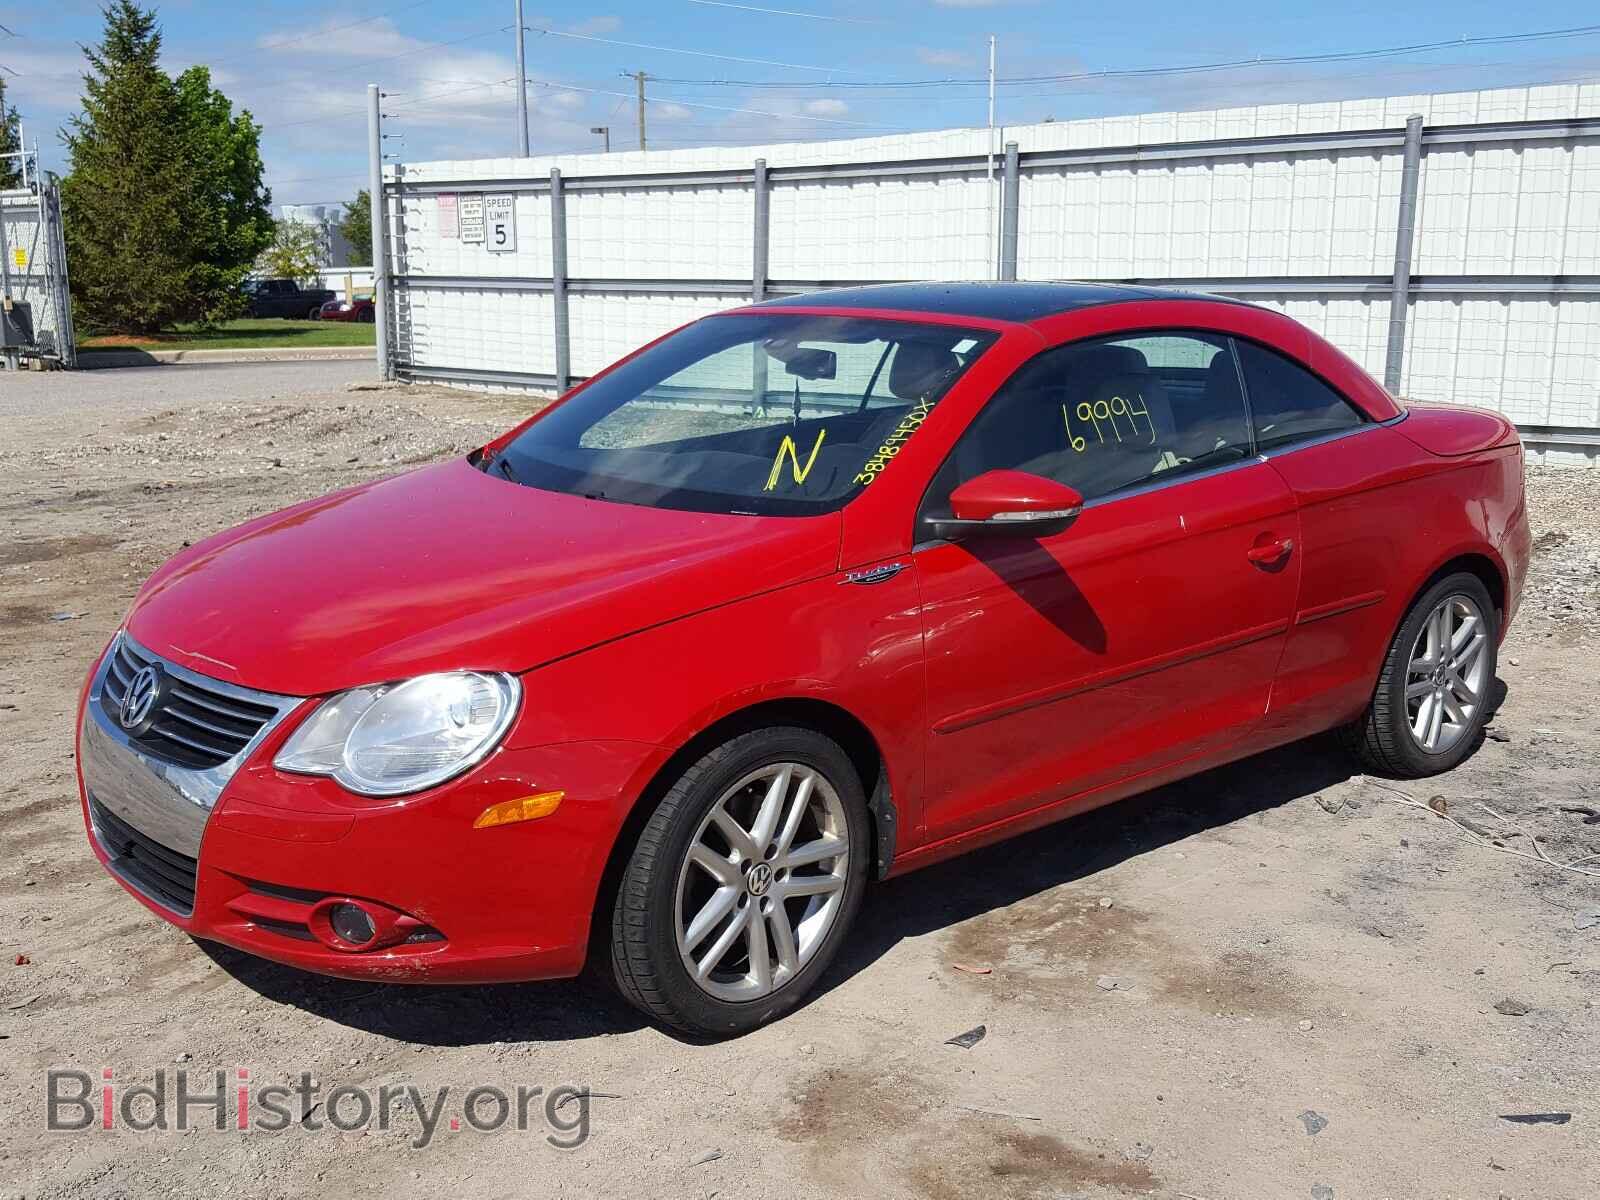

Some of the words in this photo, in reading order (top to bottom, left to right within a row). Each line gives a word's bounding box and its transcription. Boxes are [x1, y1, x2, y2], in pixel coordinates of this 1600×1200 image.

[487, 198, 511, 208] SPEED
[489, 211, 510, 221] LIMIT
[495, 224, 506, 245] 5
[1062, 393, 1156, 451] 69994
[763, 428, 826, 491] N
